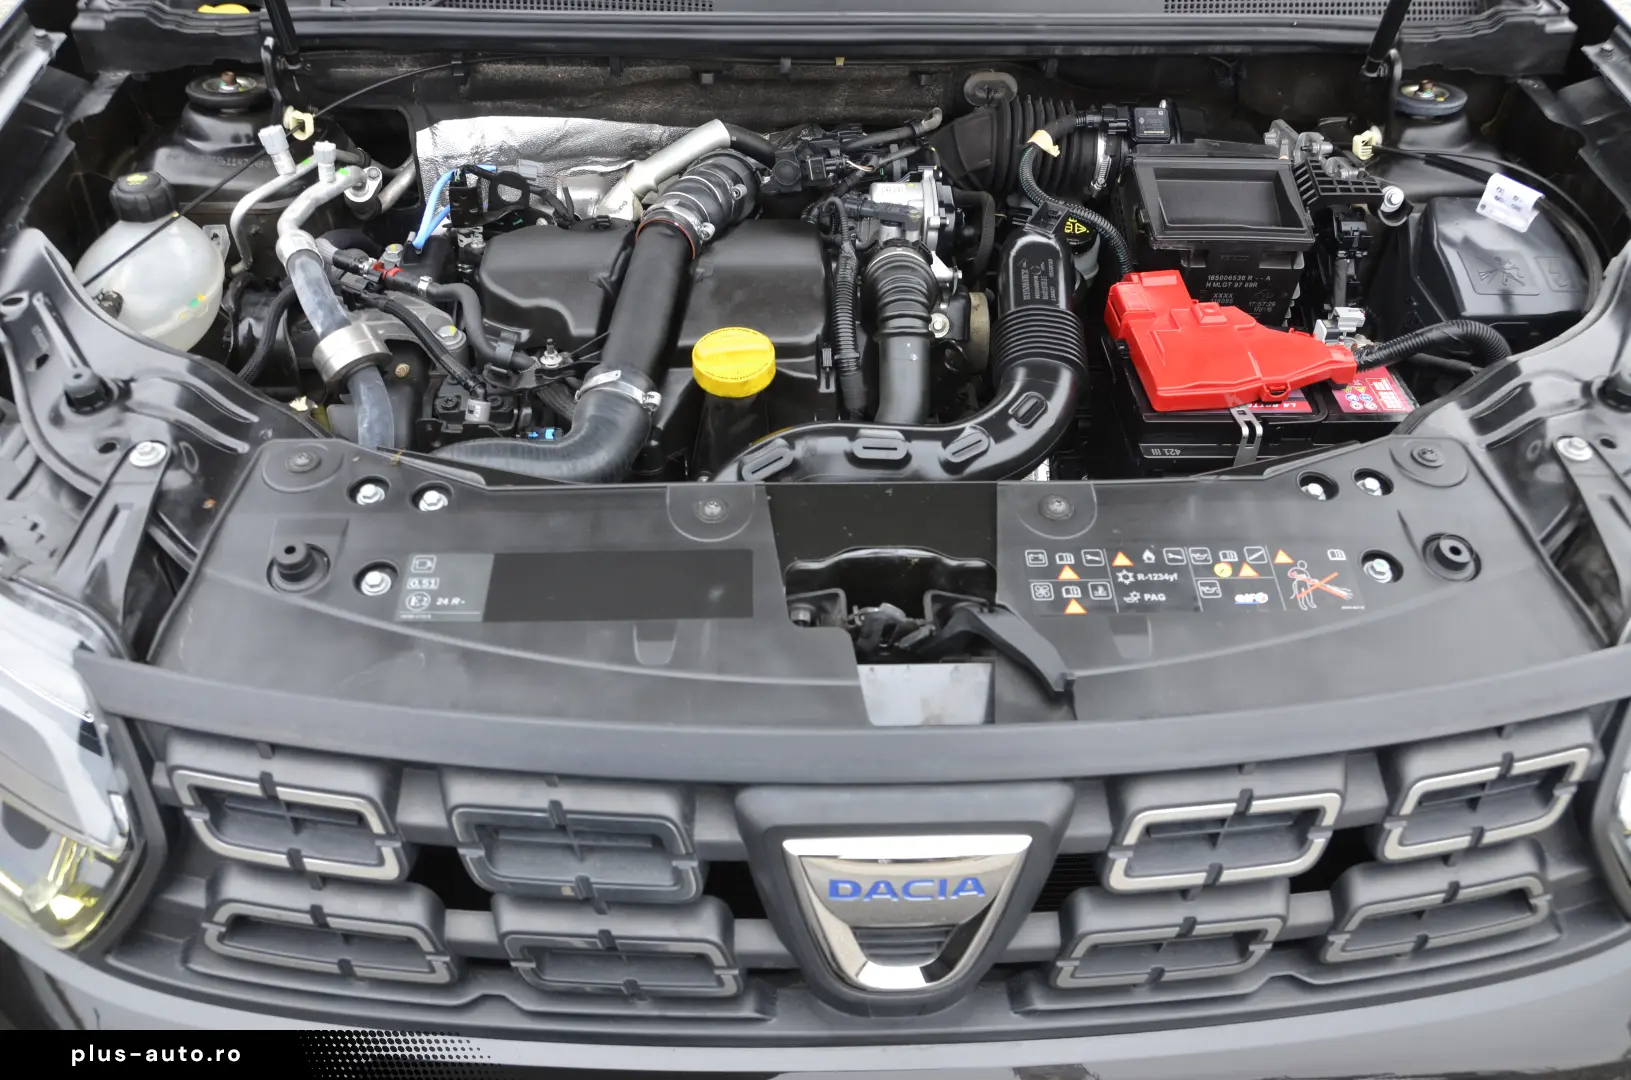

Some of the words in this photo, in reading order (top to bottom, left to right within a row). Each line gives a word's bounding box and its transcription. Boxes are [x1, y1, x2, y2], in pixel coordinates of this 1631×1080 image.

[1163, 448, 1182, 456] 421
[1143, 593, 1167, 602] PAG
[829, 877, 986, 902] DACIA
